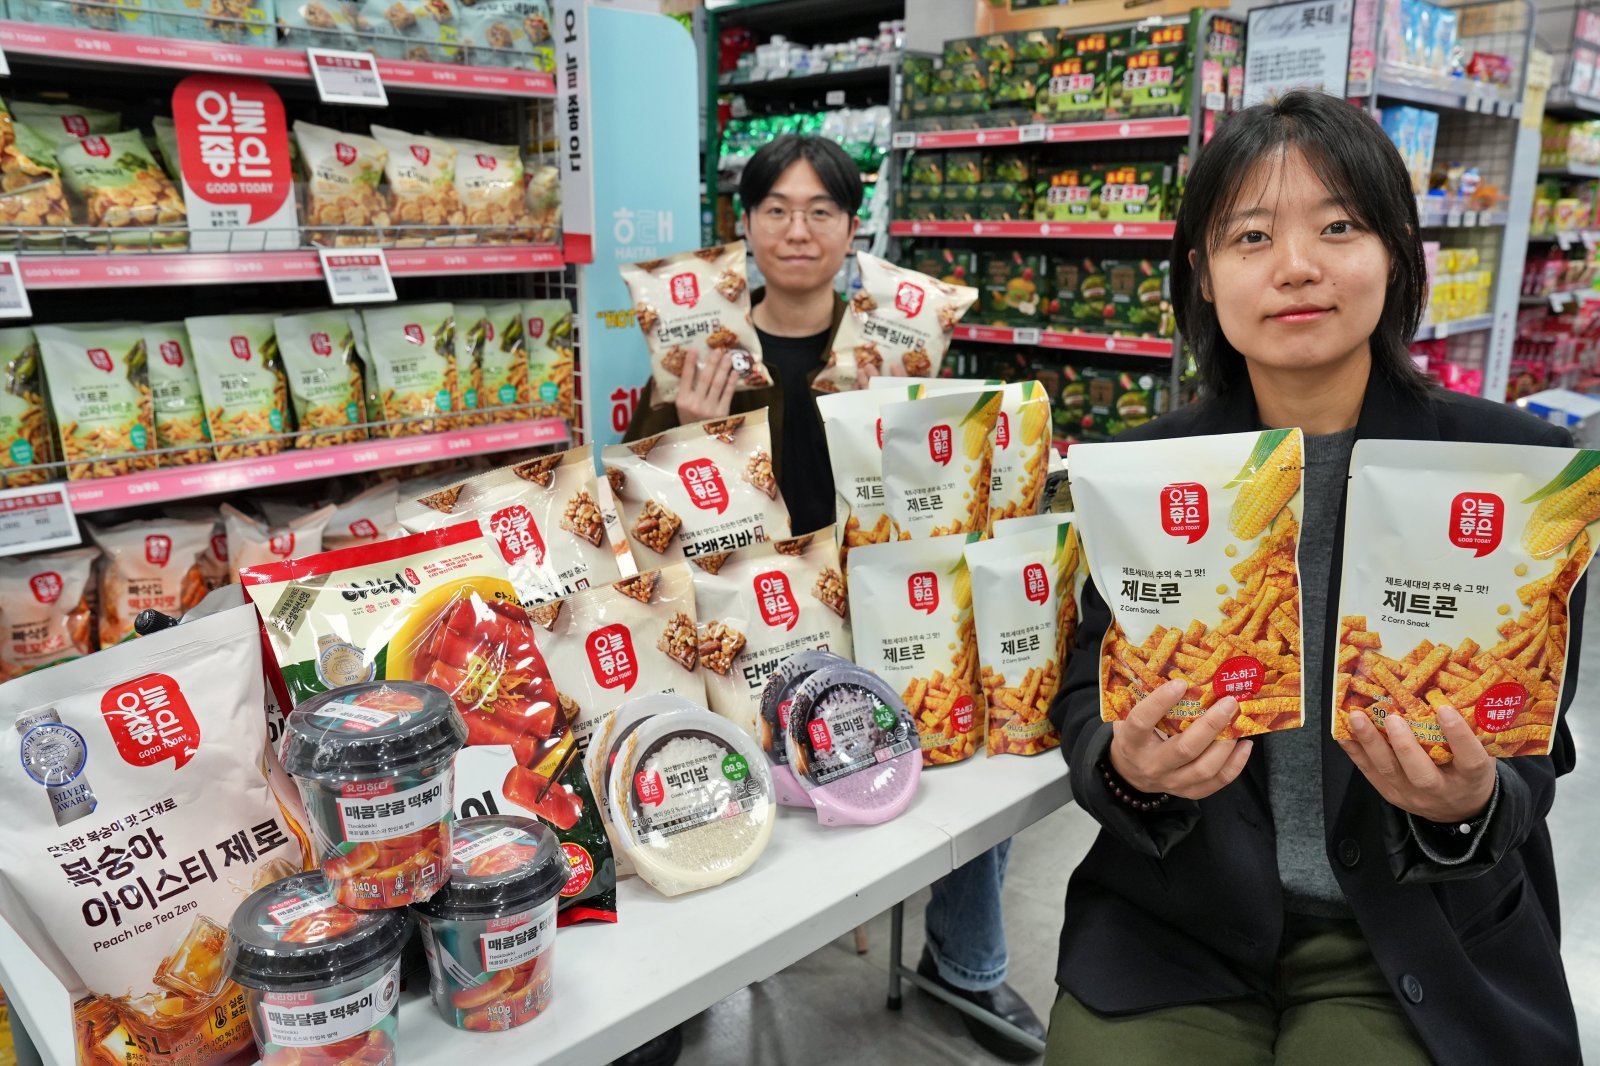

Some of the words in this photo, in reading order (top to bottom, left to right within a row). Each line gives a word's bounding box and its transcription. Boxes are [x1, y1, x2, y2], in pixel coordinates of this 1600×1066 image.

[195, 90, 267, 134] 오늘
[199, 135, 272, 178] 좋은
[206, 182, 238, 194] GOOD
[239, 182, 274, 194] TODAY
[658, 321, 709, 342] 단백질바
[864, 320, 914, 348] 단백질바
[907, 495, 943, 513] 제트콘
[1169, 488, 1199, 506] 오늘
[1169, 506, 1200, 524] 좋은
[1461, 498, 1494, 517] 오늘
[1459, 517, 1493, 536] 좋은
[913, 576, 932, 589] 오늘
[1027, 568, 1043, 581] 오늘
[1122, 567, 1154, 579] 제트세대의
[1156, 570, 1171, 579] 추억
[1174, 570, 1182, 578] 속
[1183, 570, 1192, 578] 그
[1194, 568, 1206, 578] 맛!
[760, 578, 785, 597] 오늘
[1029, 579, 1046, 593] 좋은
[1120, 580, 1181, 604] 제트콘
[1385, 576, 1430, 590] 제트세대의
[1432, 582, 1451, 592] 추억
[1453, 584, 1462, 592] 속
[1464, 584, 1473, 593] 그
[1476, 585, 1489, 594] 맛!
[914, 588, 934, 602] 좋은
[1383, 590, 1458, 619] 제트콘
[764, 595, 792, 615] 좋은
[1125, 605, 1140, 613] Corn
[1140, 605, 1160, 614] Snack
[1387, 616, 1405, 625] Corn
[1406, 618, 1430, 628] Snack
[595, 633, 625, 657] 오늘
[882, 643, 925, 663] 제트콘
[1000, 634, 1040, 656] 제트콘
[599, 651, 630, 676] 좋은
[605, 676, 619, 685] GOOD
[618, 670, 632, 680] TODAY
[1220, 668, 1258, 681] 고소하고
[1225, 681, 1253, 692] 매콤한
[117, 684, 167, 722] 오늘
[1484, 695, 1521, 707] 고소하고
[1372, 706, 1386, 718] 90
[1486, 709, 1515, 720] 매콤한
[126, 704, 183, 746] 좋은
[572, 718, 593, 732] 한입에
[832, 717, 865, 736] 흑미밥
[138, 745, 162, 759] GOOD
[162, 734, 188, 751] TODAY
[1428, 733, 1441, 741] 100
[51, 764, 68, 775] 2024
[666, 765, 709, 789] 백미밥
[53, 783, 87, 804] SILVER
[346, 780, 389, 793] 요리하다
[57, 793, 91, 813] AWARD
[139, 798, 178, 822] 그대로
[345, 800, 406, 820] 매콤달콤
[408, 783, 442, 808] 떡볶이
[60, 827, 167, 887] 복숭아
[82, 849, 219, 927] 아이스티
[215, 818, 289, 868] 제로
[353, 882, 370, 893] 140
[371, 884, 378, 894] g
[93, 929, 133, 952] Peach
[134, 920, 152, 935] Ice
[153, 909, 174, 926] Tea
[176, 900, 198, 916] Zero
[488, 925, 537, 951] 매콤달콤
[229, 994, 244, 1009] 실온
[268, 1010, 328, 1027] 매콤달콤
[330, 993, 372, 1019] 떡볶이
[487, 1005, 504, 1015] 140
[230, 1004, 247, 1020] 보관
